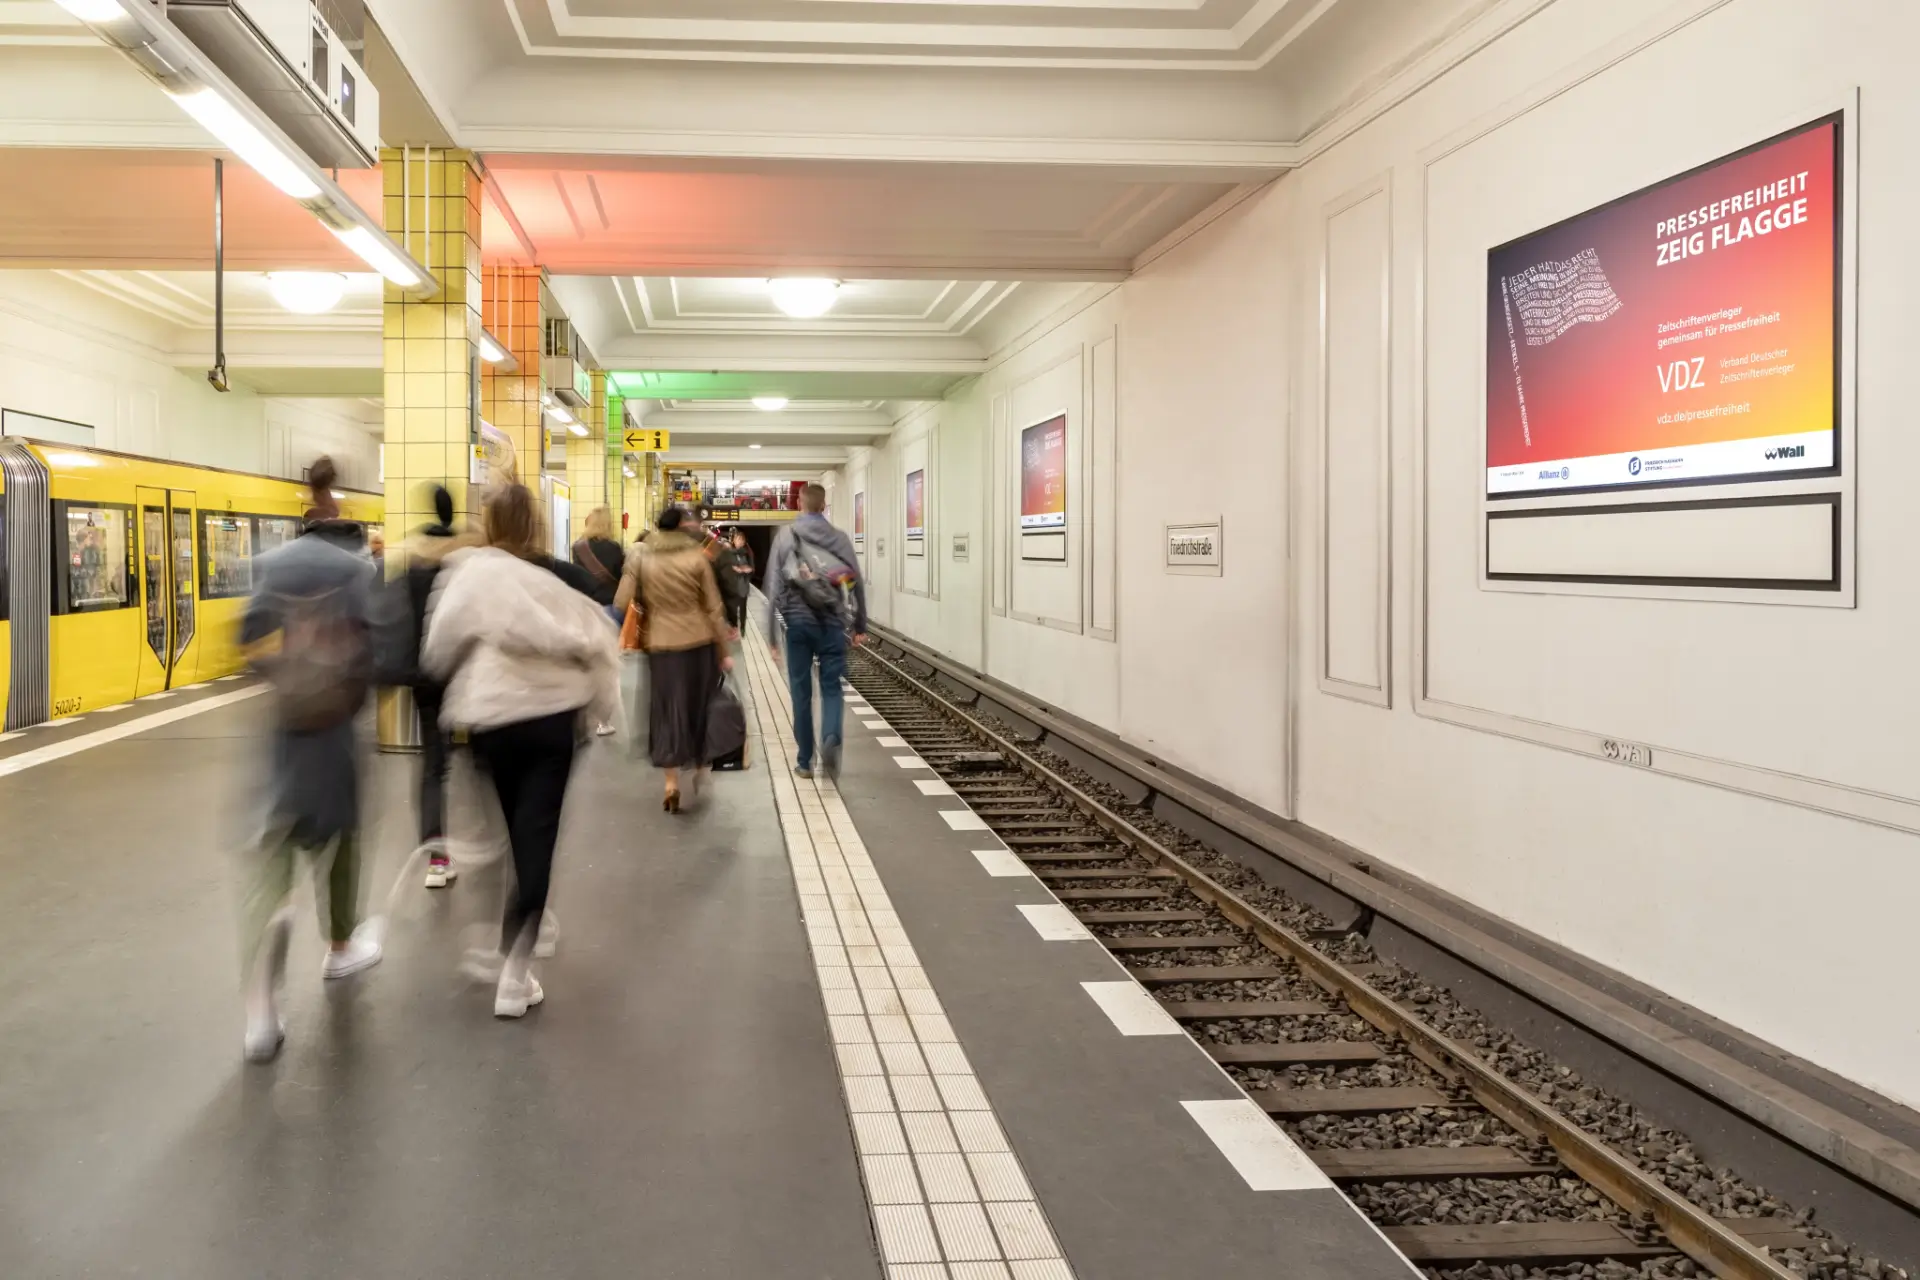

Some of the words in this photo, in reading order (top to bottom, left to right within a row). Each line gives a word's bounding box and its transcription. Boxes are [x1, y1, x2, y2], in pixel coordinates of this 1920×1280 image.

[1656, 171, 1809, 239] PRESSEFREIHEIT
[1656, 231, 1704, 266] ZEIG
[1712, 198, 1808, 250] FLAGGE
[1509, 266, 1537, 287] JEDER
[1537, 261, 1555, 273] HAT
[1555, 260, 1572, 272] DAS
[1511, 280, 1529, 295] SEINE
[1530, 272, 1559, 284] MEINUNG
[1657, 306, 1742, 333] Zeitschriftenverleger
[1657, 330, 1702, 349] gemeinsam
[1705, 326, 1717, 336] für
[1719, 311, 1780, 333] Pressefreiheit
[1720, 355, 1748, 368] Verband
[1750, 348, 1788, 363] Deutscher
[1657, 356, 1705, 393] VDZ
[1720, 363, 1795, 384] Zeitschriftenverleger
[1657, 402, 1751, 424] vdz.de/pressefreiheit
[1777, 445, 1805, 459] Wall
[1538, 470, 1560, 480] Allianz
[1170, 536, 1212, 556] Friedrichstraße
[54, 696, 82, 717] 5020-3
